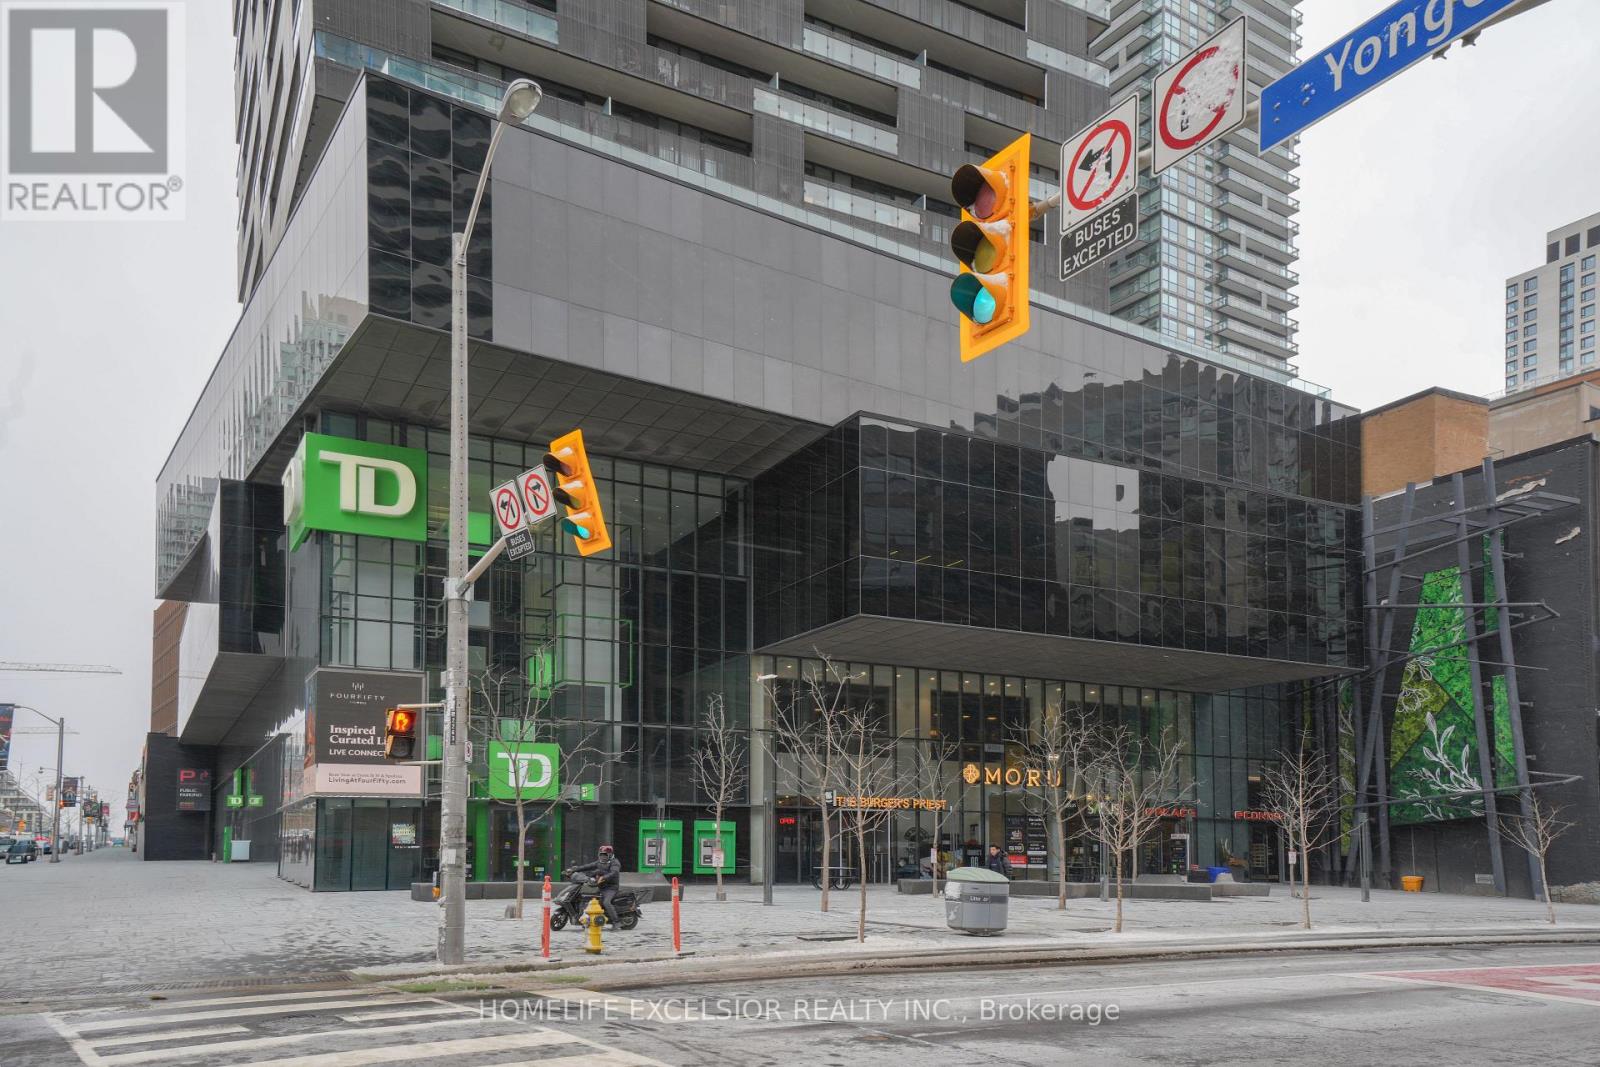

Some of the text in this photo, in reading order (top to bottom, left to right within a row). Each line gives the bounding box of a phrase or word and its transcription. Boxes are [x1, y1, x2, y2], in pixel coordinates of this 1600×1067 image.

[1075, 207, 1121, 248] BUSES
[1063, 222, 1134, 275] EXCEPTED
[319, 449, 417, 517] TD
[510, 533, 526, 547] BUSES
[509, 541, 533, 558] EXCEPTED
[330, 692, 385, 701] FOURFIFTY
[330, 724, 376, 737] Inspired
[330, 735, 374, 745] Curated
[180, 769, 196, 781] P
[497, 753, 552, 788] TD
[860, 796, 910, 809] BURGER'S
[912, 799, 947, 810] PRIEST
[779, 817, 795, 825] OPEN
